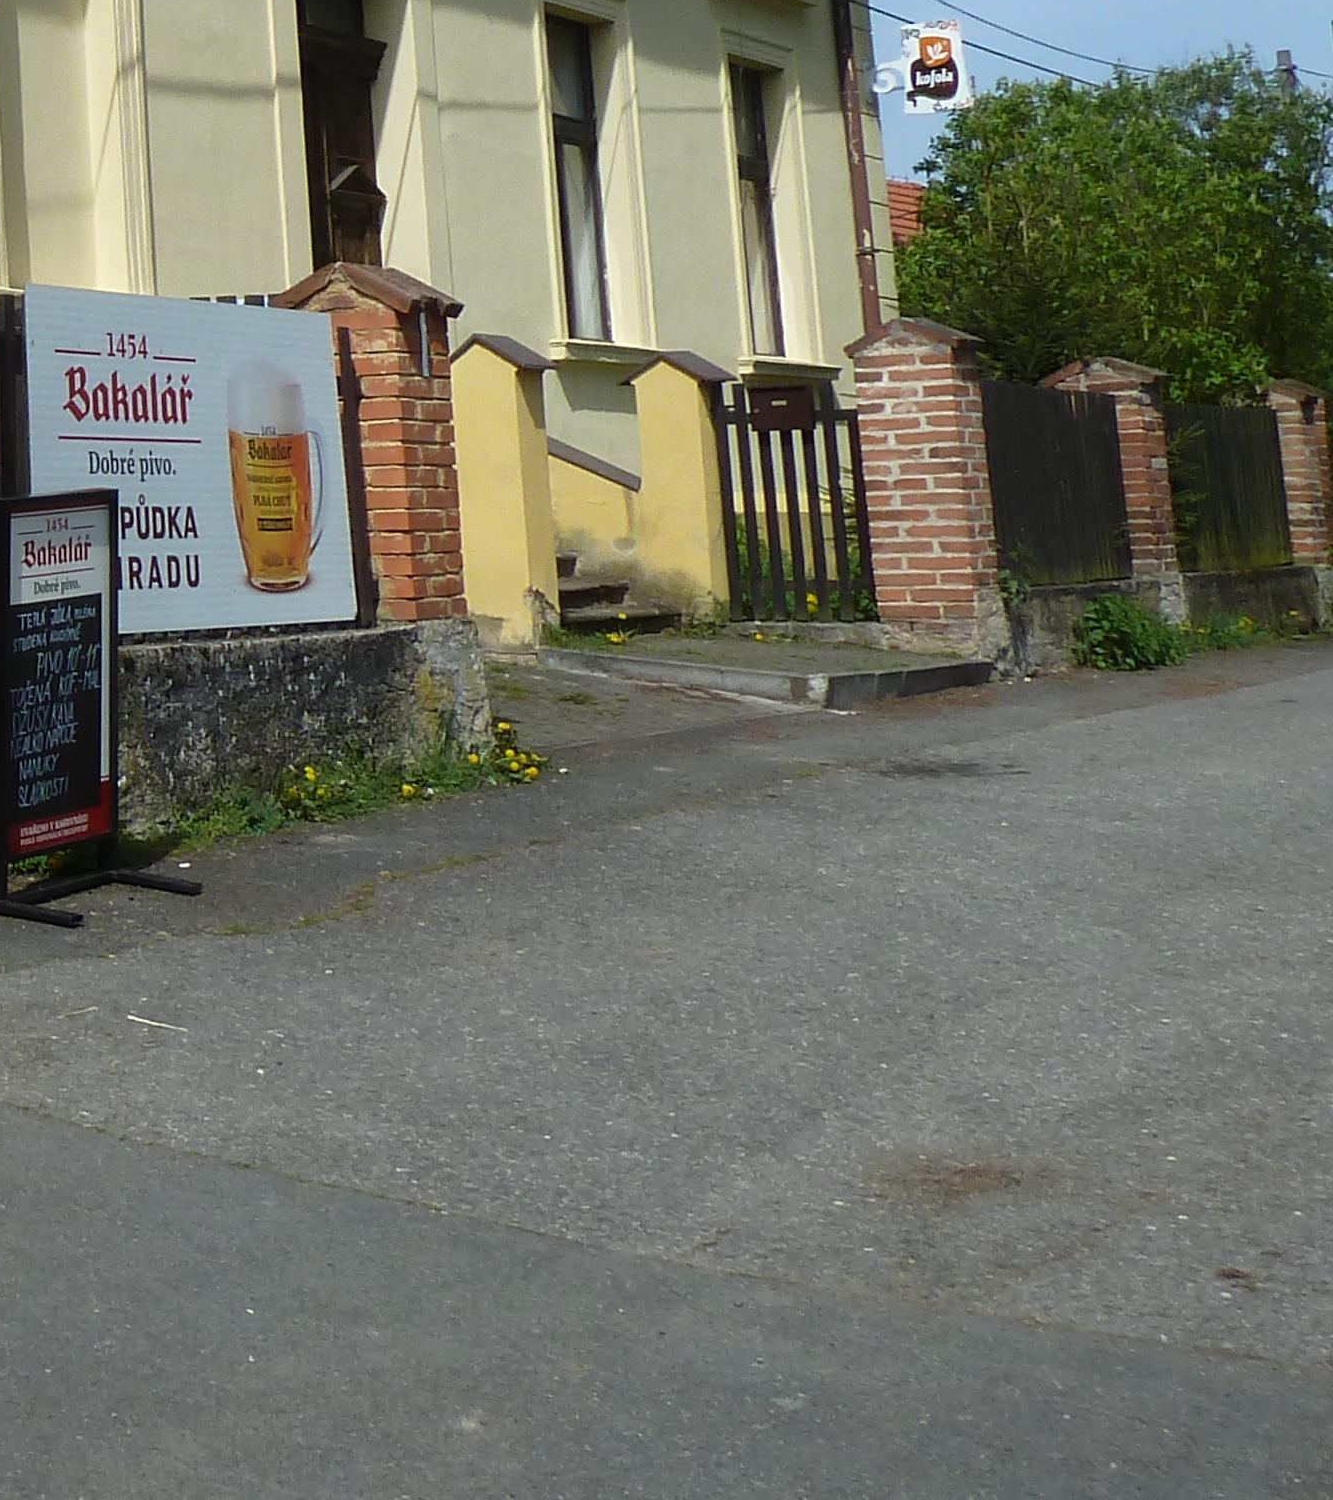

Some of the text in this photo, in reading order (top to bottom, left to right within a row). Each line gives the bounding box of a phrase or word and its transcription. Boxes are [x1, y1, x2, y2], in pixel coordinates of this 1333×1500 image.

[915, 68, 954, 89] kofola
[106, 332, 149, 360] 1454
[63, 365, 194, 425] Bakalář
[88, 448, 178, 482] Dobré pivo.
[45, 517, 69, 533] 1454
[120, 493, 199, 540] PŮDKA
[21, 534, 92, 568] Bakalář
[33, 576, 82, 596] Dobré pivo.
[12, 627, 48, 654] STUDENÁ
[37, 648, 64, 679] PIVO
[10, 674, 53, 707] TOČENÁ
[18, 752, 62, 781] NANUKY
[17, 772, 70, 809] SLADKOSTI
